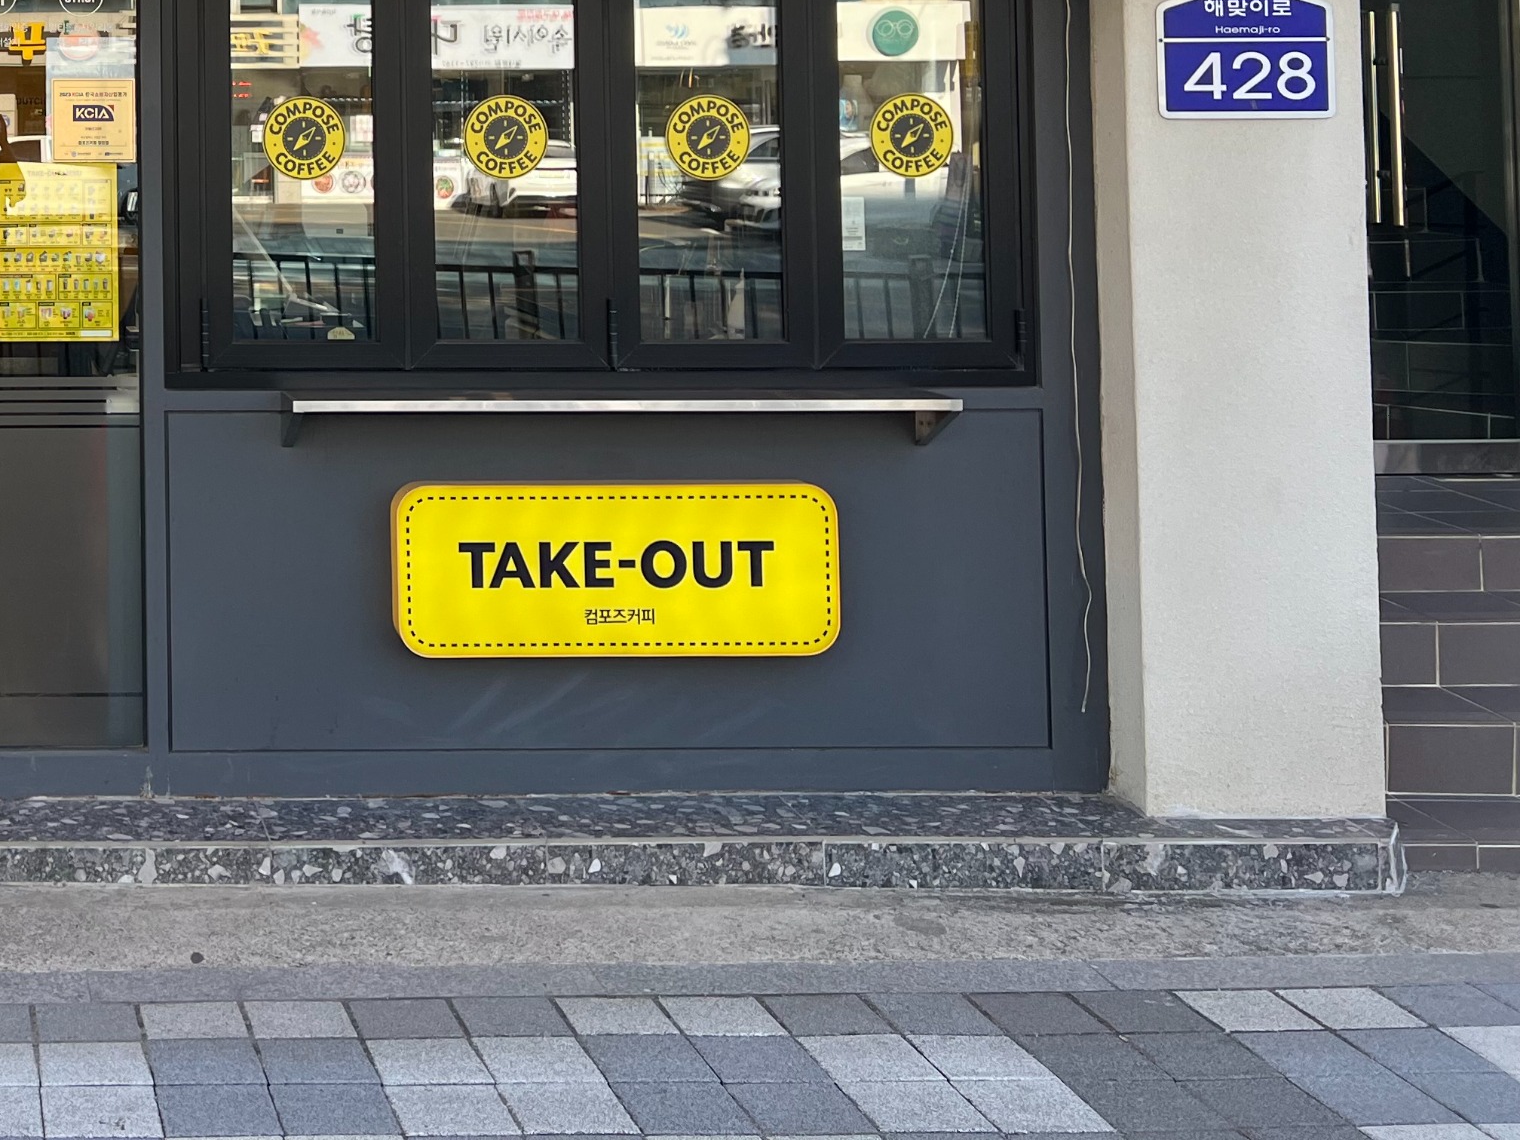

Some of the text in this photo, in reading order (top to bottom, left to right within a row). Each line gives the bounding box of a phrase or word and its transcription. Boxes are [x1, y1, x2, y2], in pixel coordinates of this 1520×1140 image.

[1214, 25, 1281, 35] Haemaji-ro
[1183, 50, 1317, 101] 428
[75, 107, 110, 119] KCIA
[269, 101, 341, 136] COMPOSE
[470, 100, 543, 135] COMPOSE
[673, 100, 745, 134] COMPOSE
[876, 98, 949, 133] COMPOSE
[274, 150, 337, 176] COFFEE
[476, 150, 538, 175] COFFEE
[678, 149, 741, 175] COFFEE
[882, 148, 944, 173] COFFEE
[458, 540, 774, 589] TAKE-OUT
[583, 607, 657, 626] 컴포즈커피
